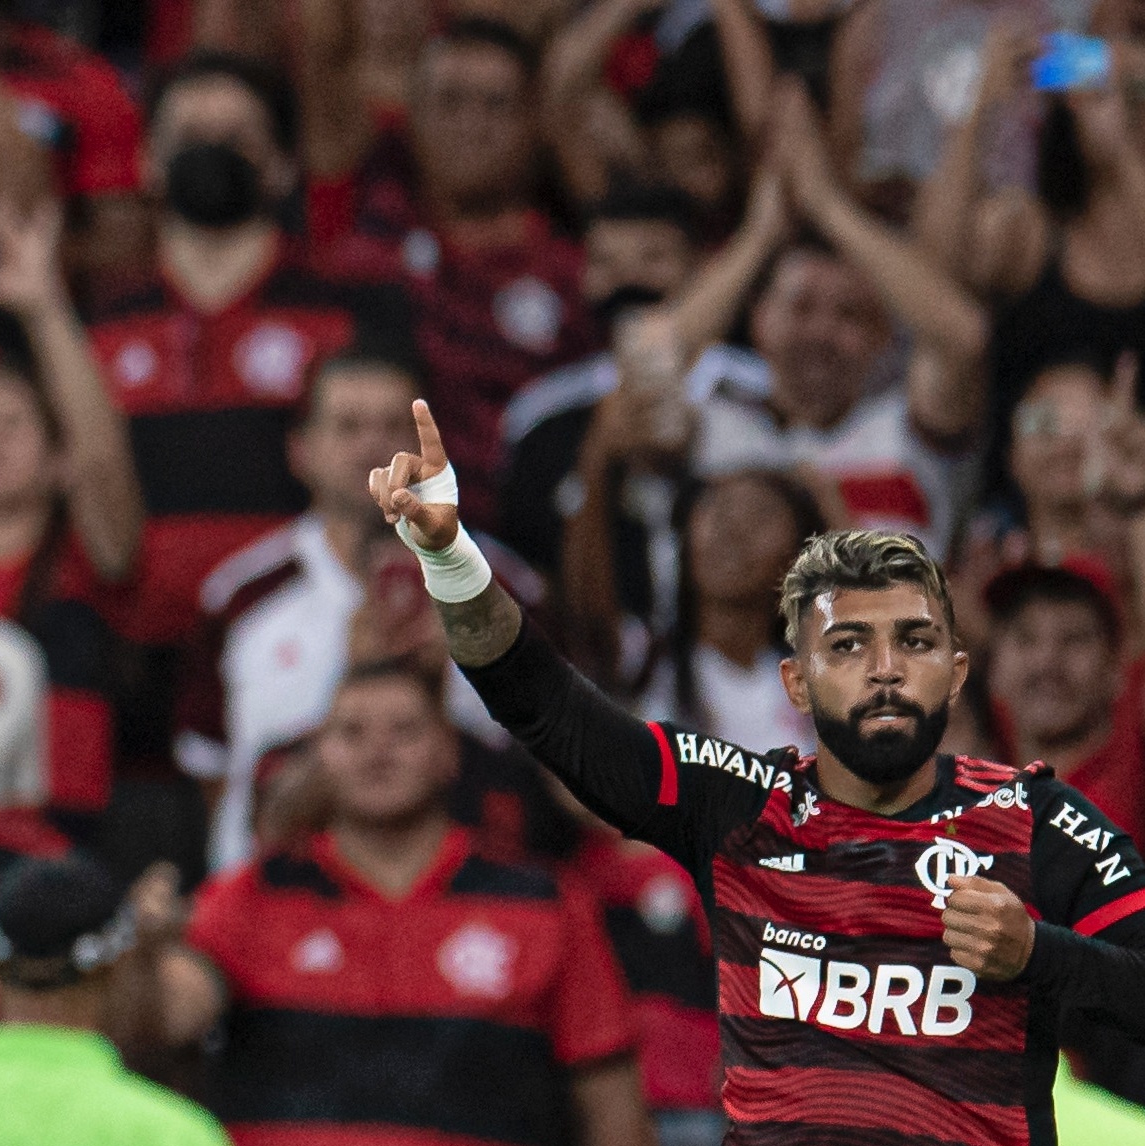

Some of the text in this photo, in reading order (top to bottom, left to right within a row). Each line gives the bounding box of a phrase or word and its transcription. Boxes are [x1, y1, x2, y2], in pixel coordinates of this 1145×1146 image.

[676, 733, 775, 789] HAVAN
[1050, 802, 1131, 886] HAN
[763, 922, 827, 951] banco
[816, 960, 977, 1036] BRB
